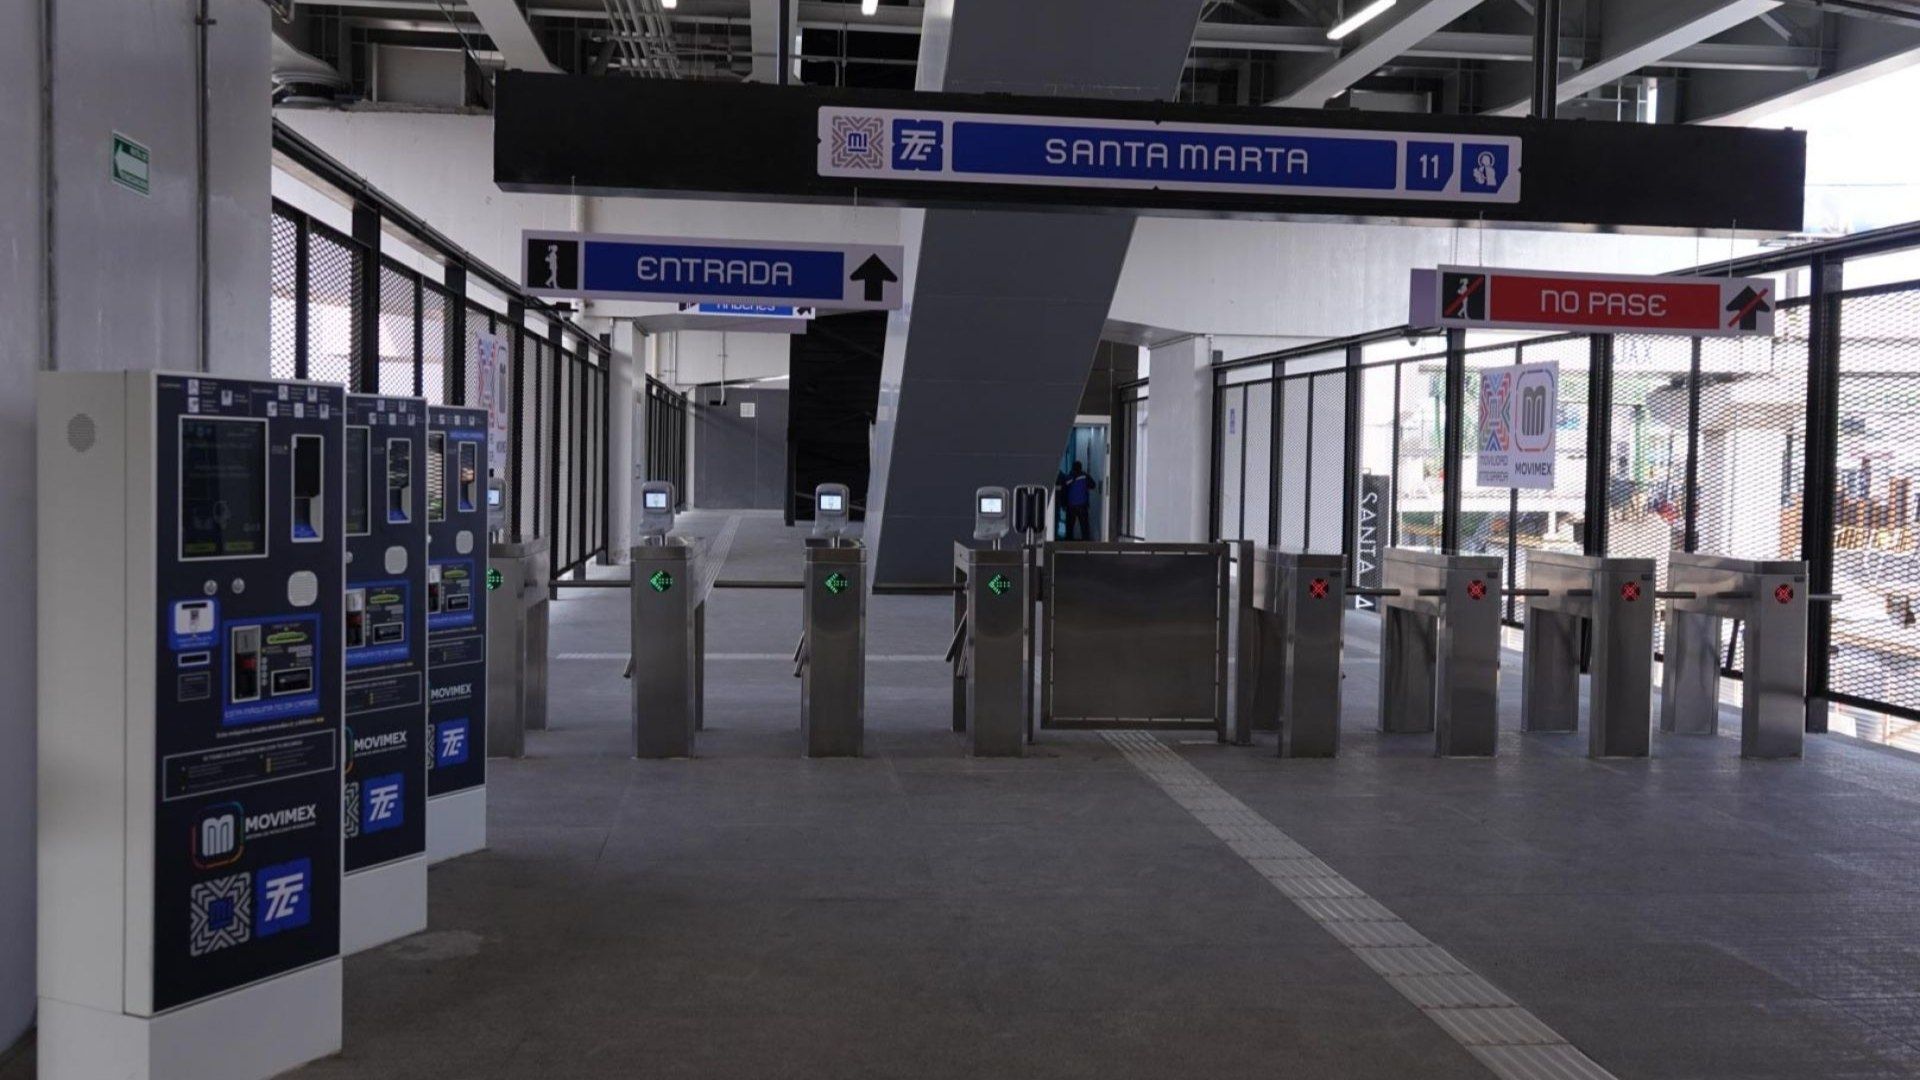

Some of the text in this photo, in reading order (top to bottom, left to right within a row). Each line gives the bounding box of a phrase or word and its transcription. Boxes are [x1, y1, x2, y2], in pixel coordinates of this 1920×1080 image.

[1045, 138, 1308, 175] SANTA MARTA
[1419, 154, 1439, 179] 11
[637, 256, 793, 286] ENTRADA
[1541, 289, 1667, 317] NO PASE
[1514, 461, 1552, 476] MOVIMEX
[1359, 492, 1378, 574] SANTA
[430, 683, 472, 699] MOVIMEX
[353, 730, 408, 751] MOVIMEX
[245, 804, 316, 832] MOVIMEX
